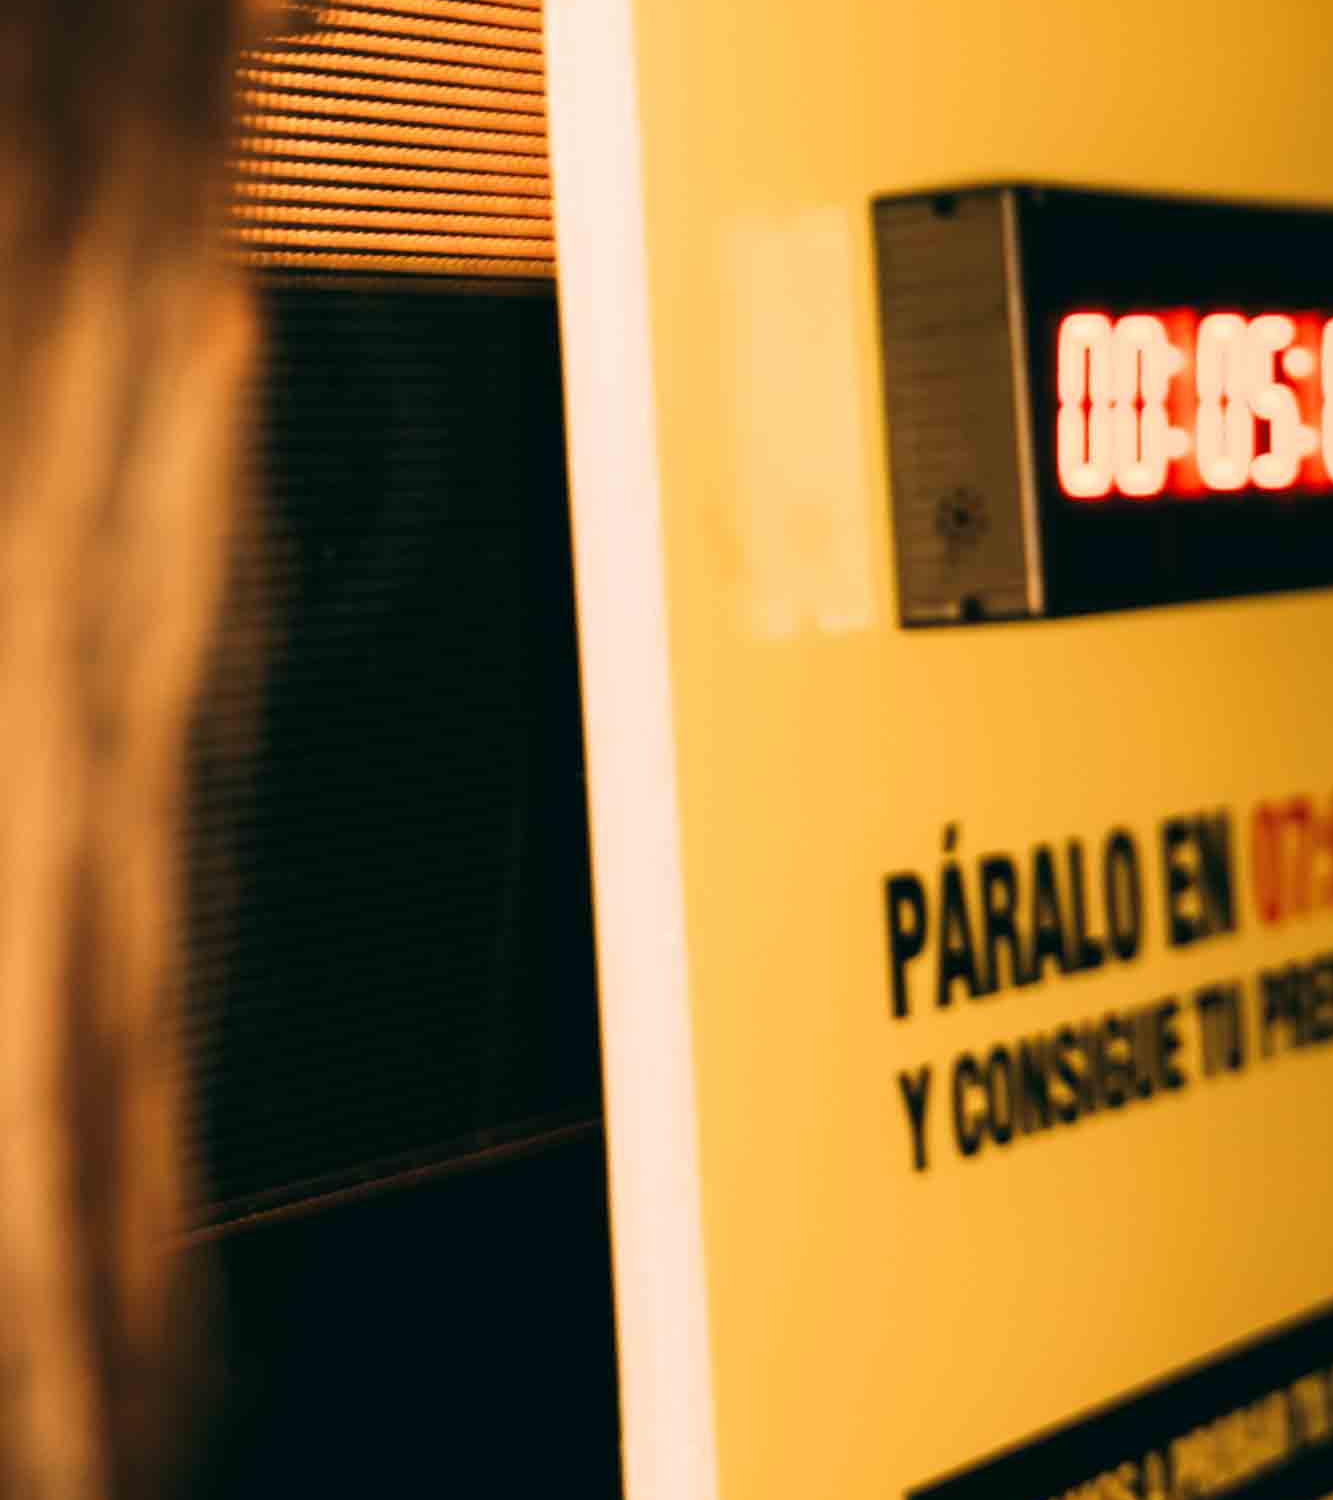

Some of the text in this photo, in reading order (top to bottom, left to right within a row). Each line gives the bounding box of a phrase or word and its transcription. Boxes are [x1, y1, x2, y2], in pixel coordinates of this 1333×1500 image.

[884, 822, 1142, 1021] PÁRALO
[1161, 808, 1239, 950] EN
[898, 1066, 932, 1174] Y
[950, 996, 1187, 1158] CONSIGUE
[1194, 978, 1245, 1079] TU
